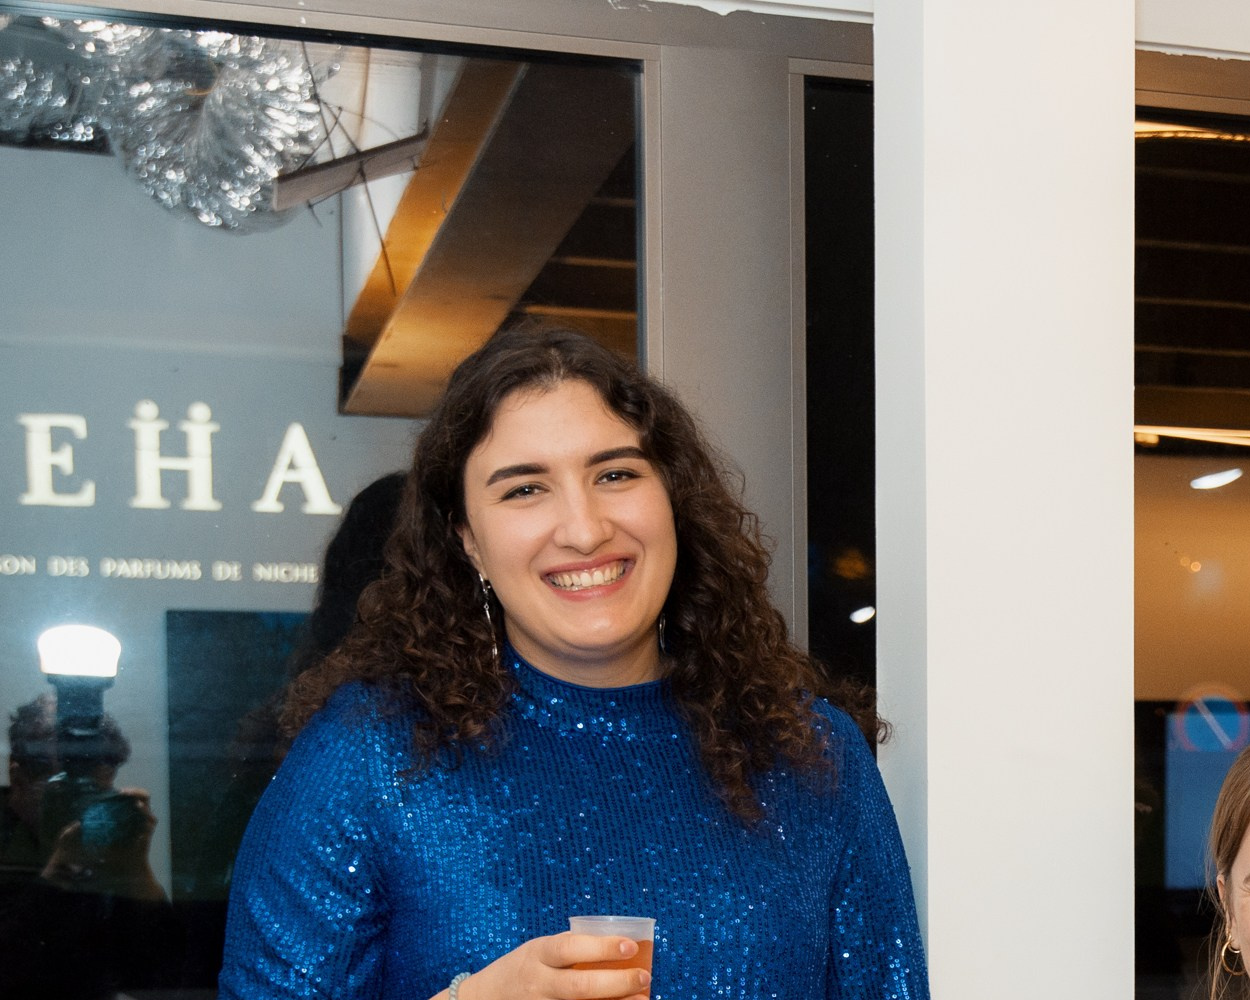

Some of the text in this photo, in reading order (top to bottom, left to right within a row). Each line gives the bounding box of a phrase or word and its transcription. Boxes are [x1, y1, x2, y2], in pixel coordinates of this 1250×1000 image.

[47, 556, 89, 577] DES
[101, 557, 201, 580] PARFUMS
[212, 561, 242, 581] DE
[252, 562, 319, 583] NICHE
